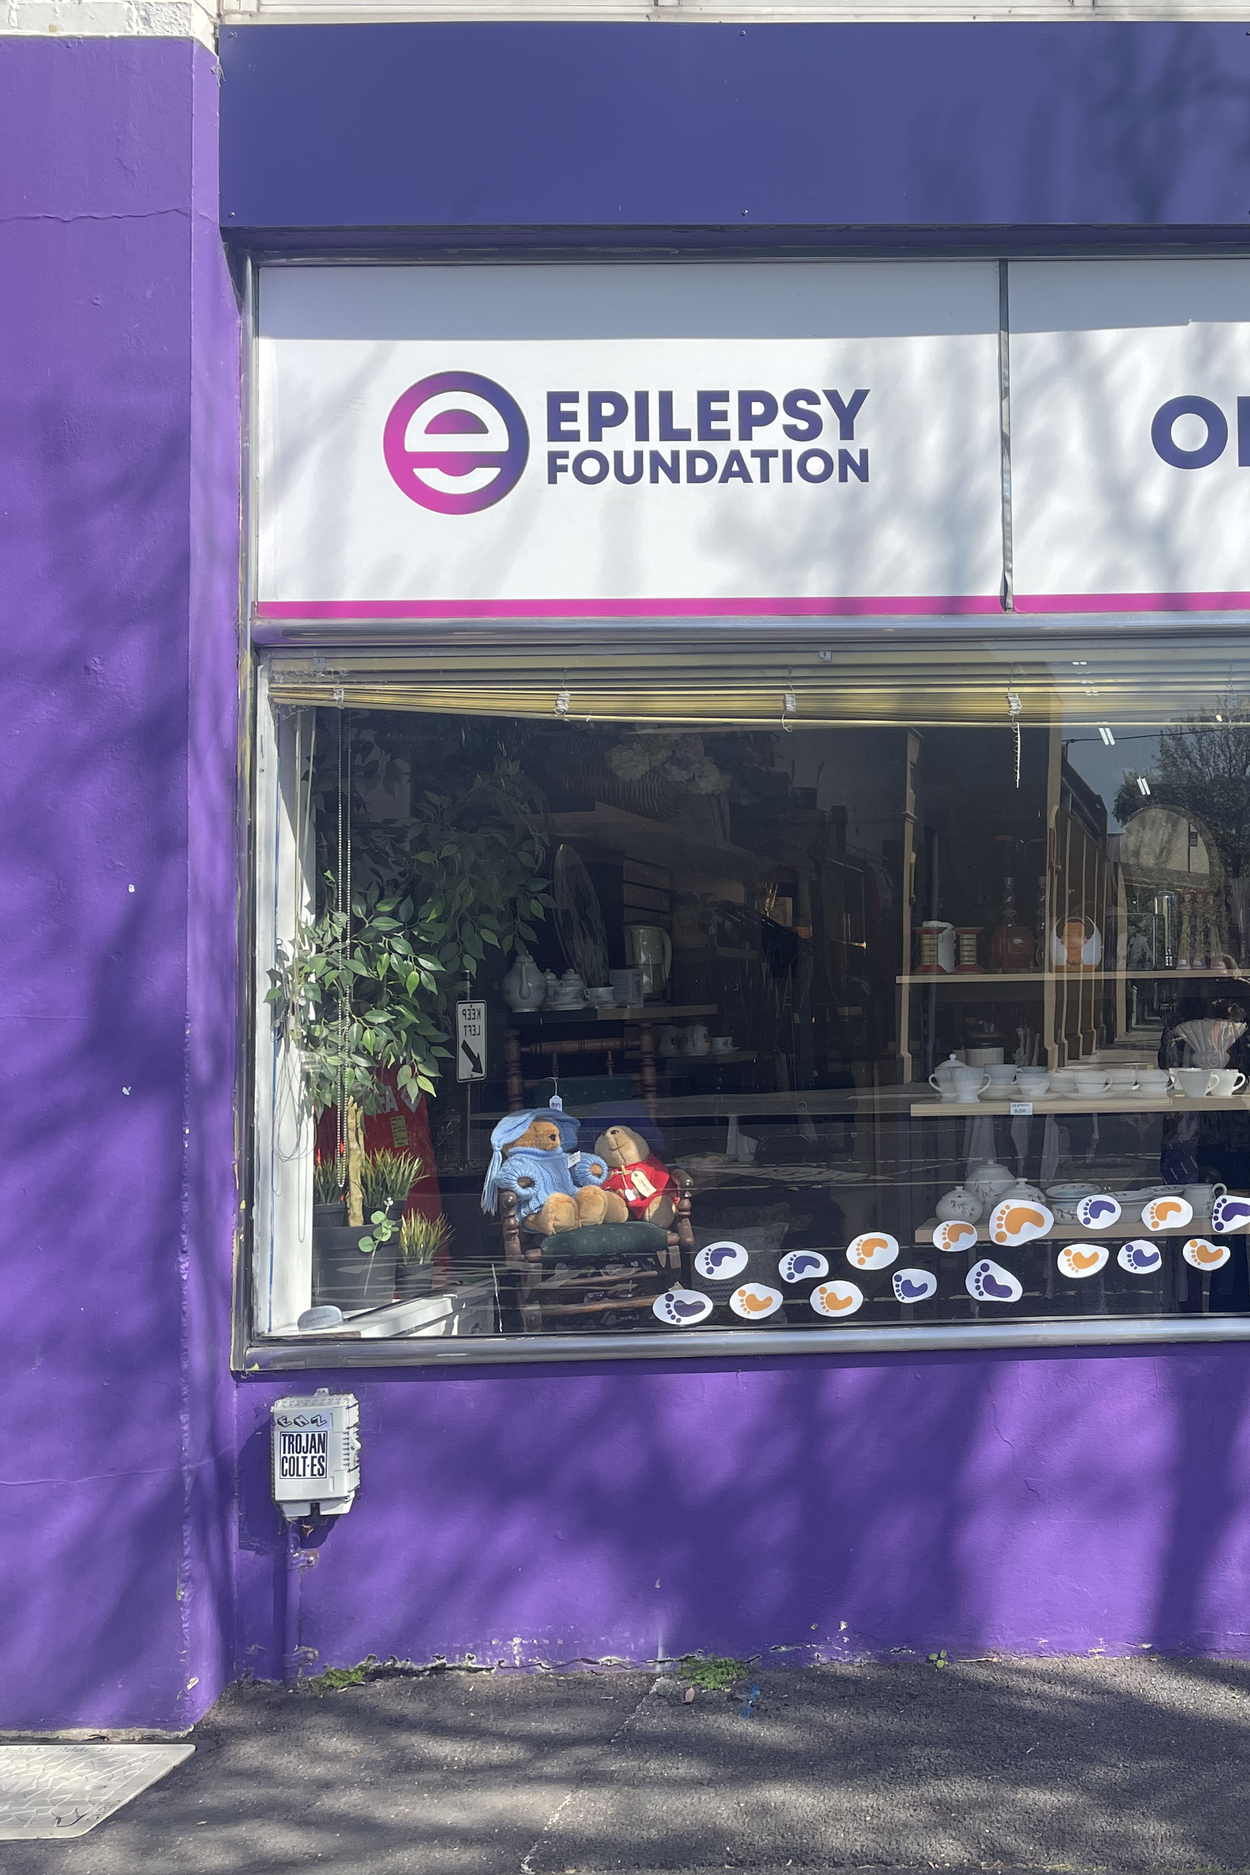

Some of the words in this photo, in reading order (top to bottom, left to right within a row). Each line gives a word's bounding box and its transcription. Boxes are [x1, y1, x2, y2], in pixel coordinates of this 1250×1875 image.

[546, 388, 871, 442] EPILEPSY
[547, 448, 869, 485] FOUNDATION
[281, 1433, 326, 1455] TROJAN
